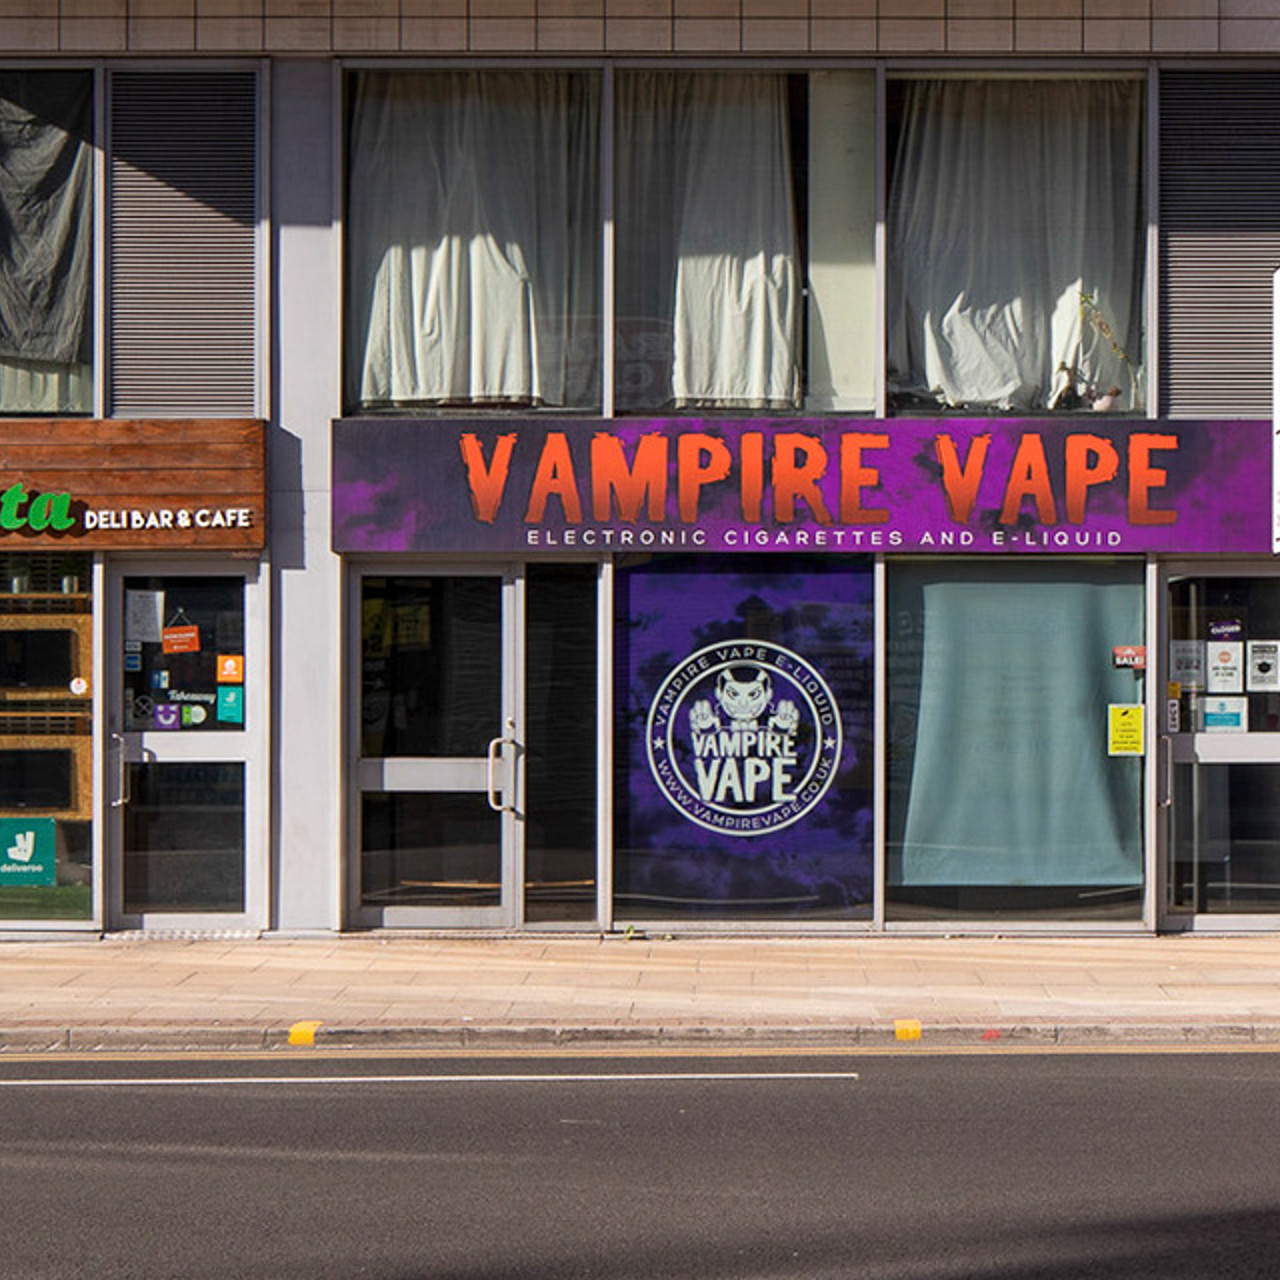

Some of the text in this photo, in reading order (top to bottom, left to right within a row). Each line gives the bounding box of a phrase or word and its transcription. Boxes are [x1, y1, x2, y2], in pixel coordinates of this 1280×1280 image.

[459, 431, 1179, 526] VAMPIRE VAPE
[85, 508, 251, 529] DELI BAR & CAFE
[527, 530, 1122, 546] ELECTRONIC CIGARETTES AND E-LIQUID
[656, 646, 834, 726] VAMPIRE VAPE E-LIQUID
[690, 731, 798, 758] VAMPIRE
[657, 757, 833, 830] WWW.VAMPIREVAPE.CO.UK
[694, 758, 797, 803] VAPE
